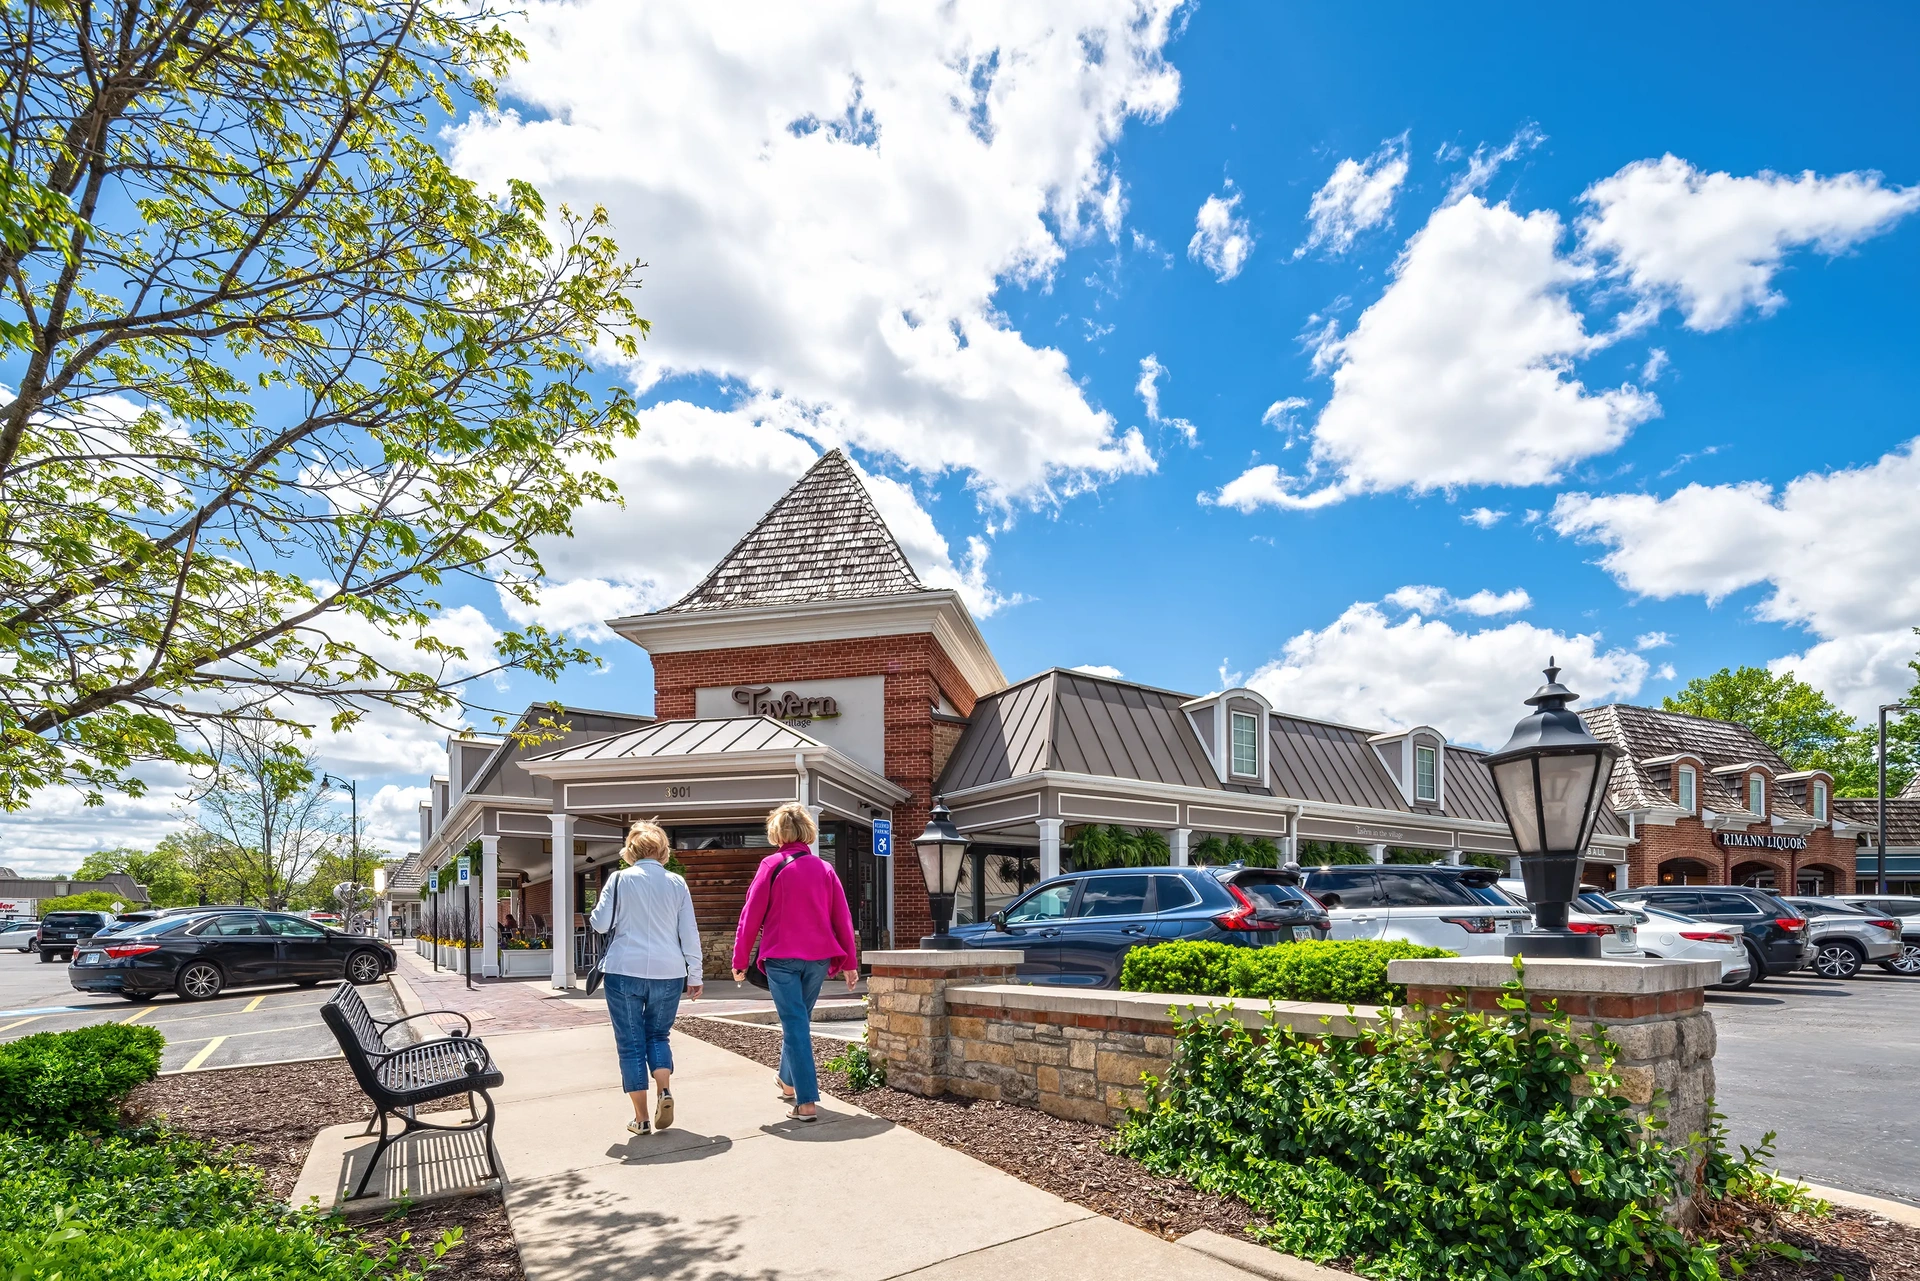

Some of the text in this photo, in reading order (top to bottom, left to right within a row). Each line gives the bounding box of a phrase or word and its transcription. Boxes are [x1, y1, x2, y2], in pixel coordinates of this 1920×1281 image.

[731, 686, 838, 718] Tavern
[665, 786, 691, 798] 3901
[717, 832, 745, 846] 3901
[1355, 825, 1372, 836] Tavern
[1379, 829, 1387, 837] the
[1389, 831, 1404, 839] village
[1723, 833, 1807, 850] RIMANN LIQUORS
[1586, 847, 1606, 856] BALL
